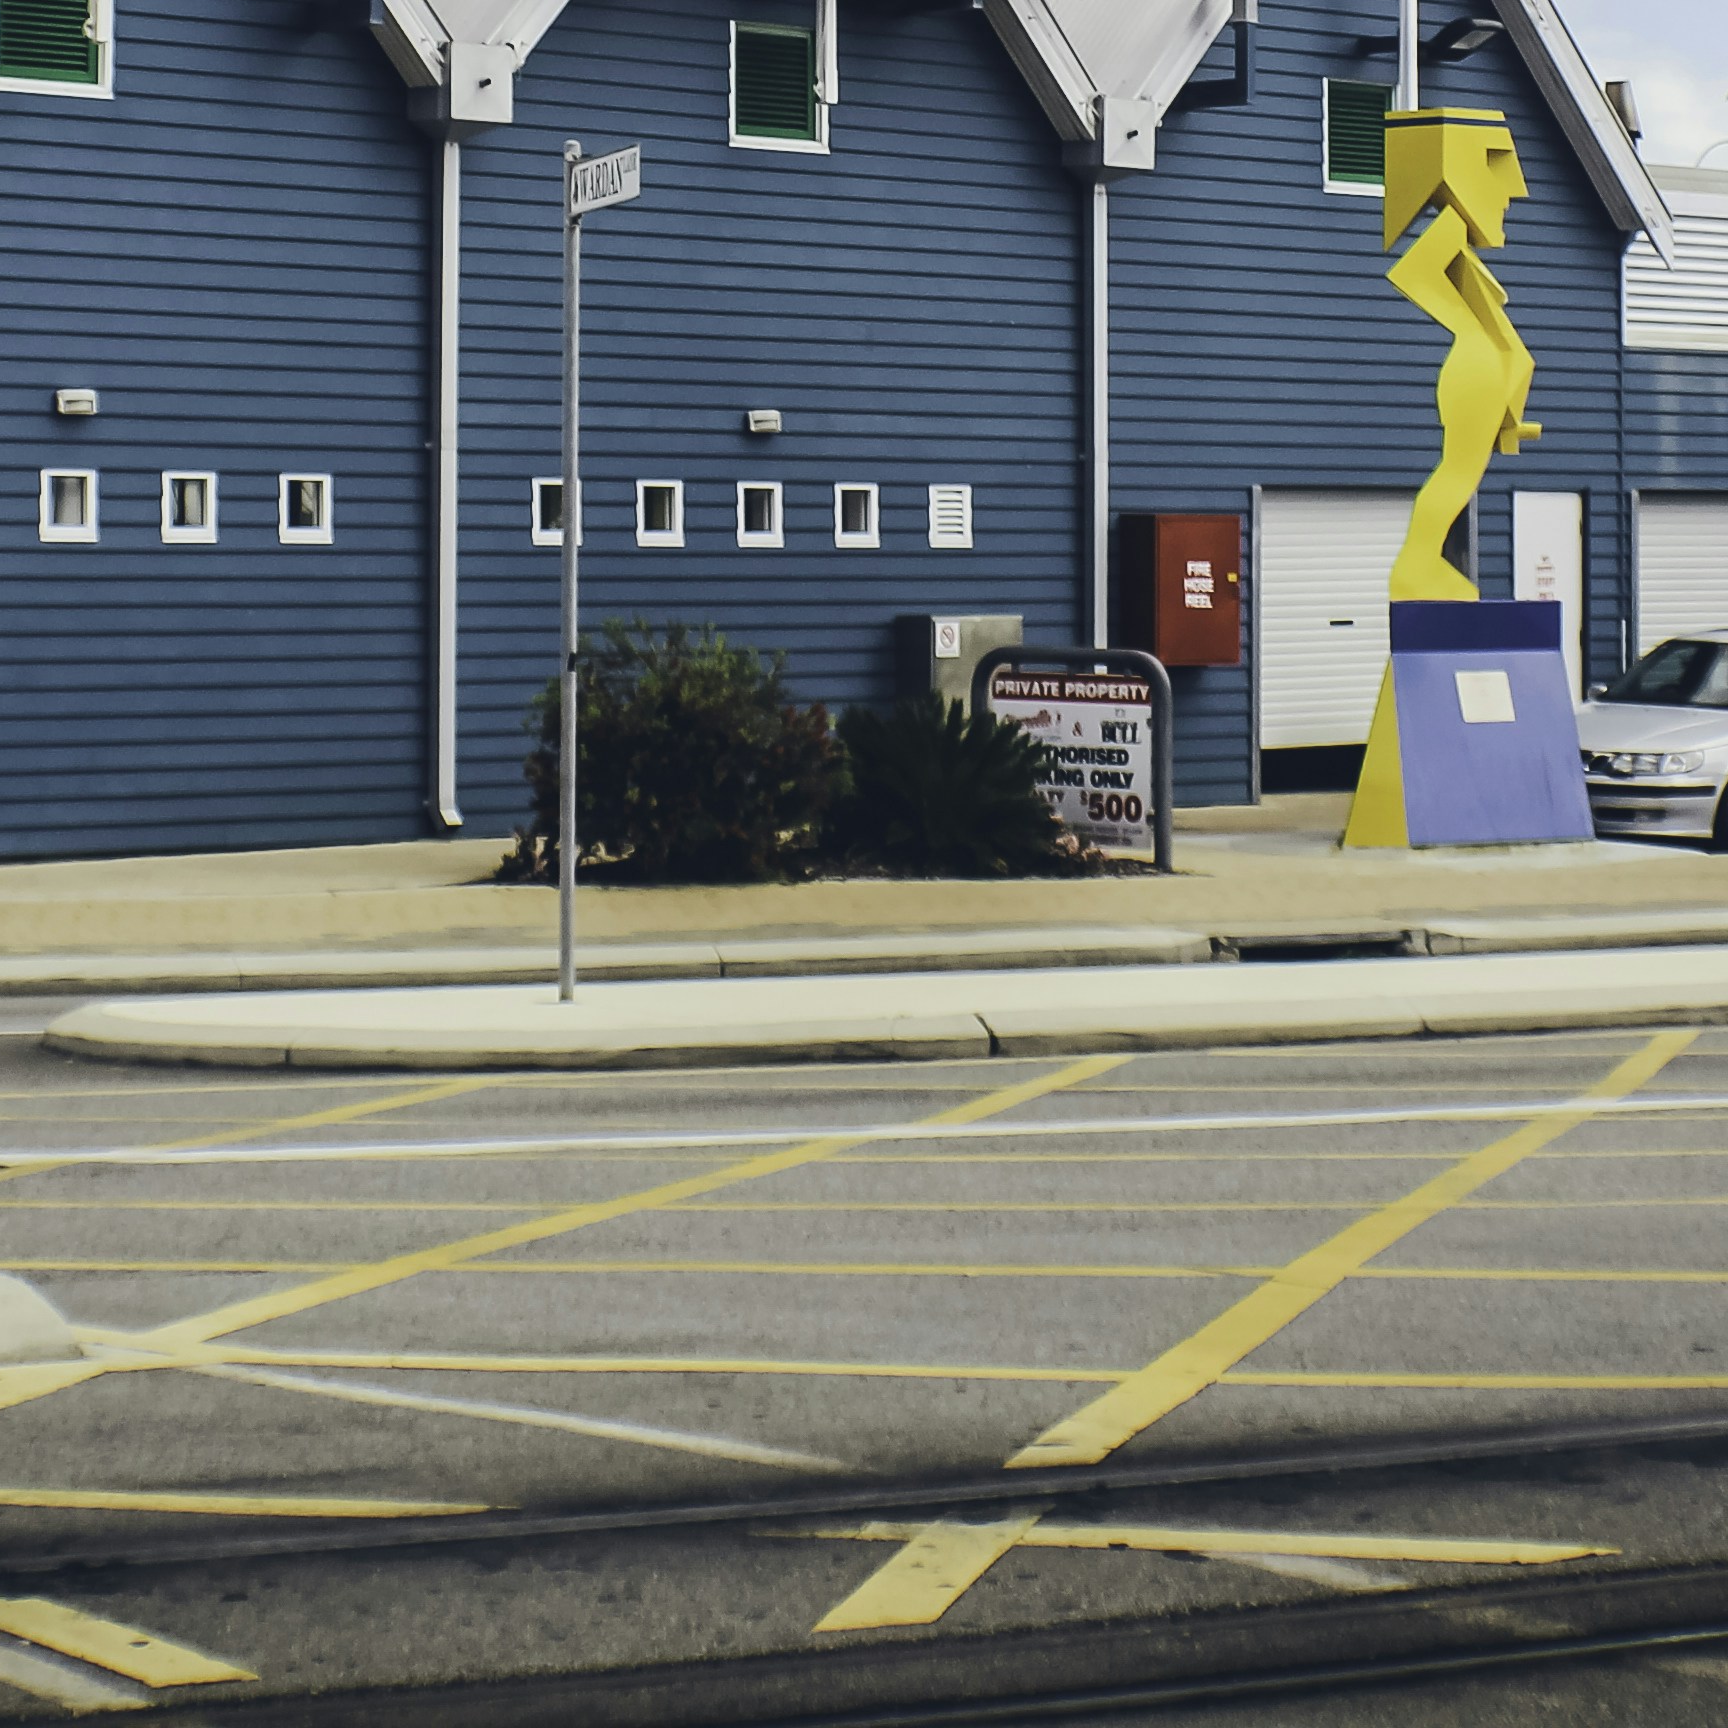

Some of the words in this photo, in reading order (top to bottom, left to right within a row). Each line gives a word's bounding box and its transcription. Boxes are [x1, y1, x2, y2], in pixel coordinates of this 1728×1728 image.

[1183, 577, 1215, 593] HOSE
[995, 680, 1060, 697] PRIVATE
[1065, 682, 1149, 701] PROPERTY
[1044, 745, 1129, 766] THORISED
[1090, 770, 1134, 789] ONLY
[1080, 790, 1143, 823] $500
